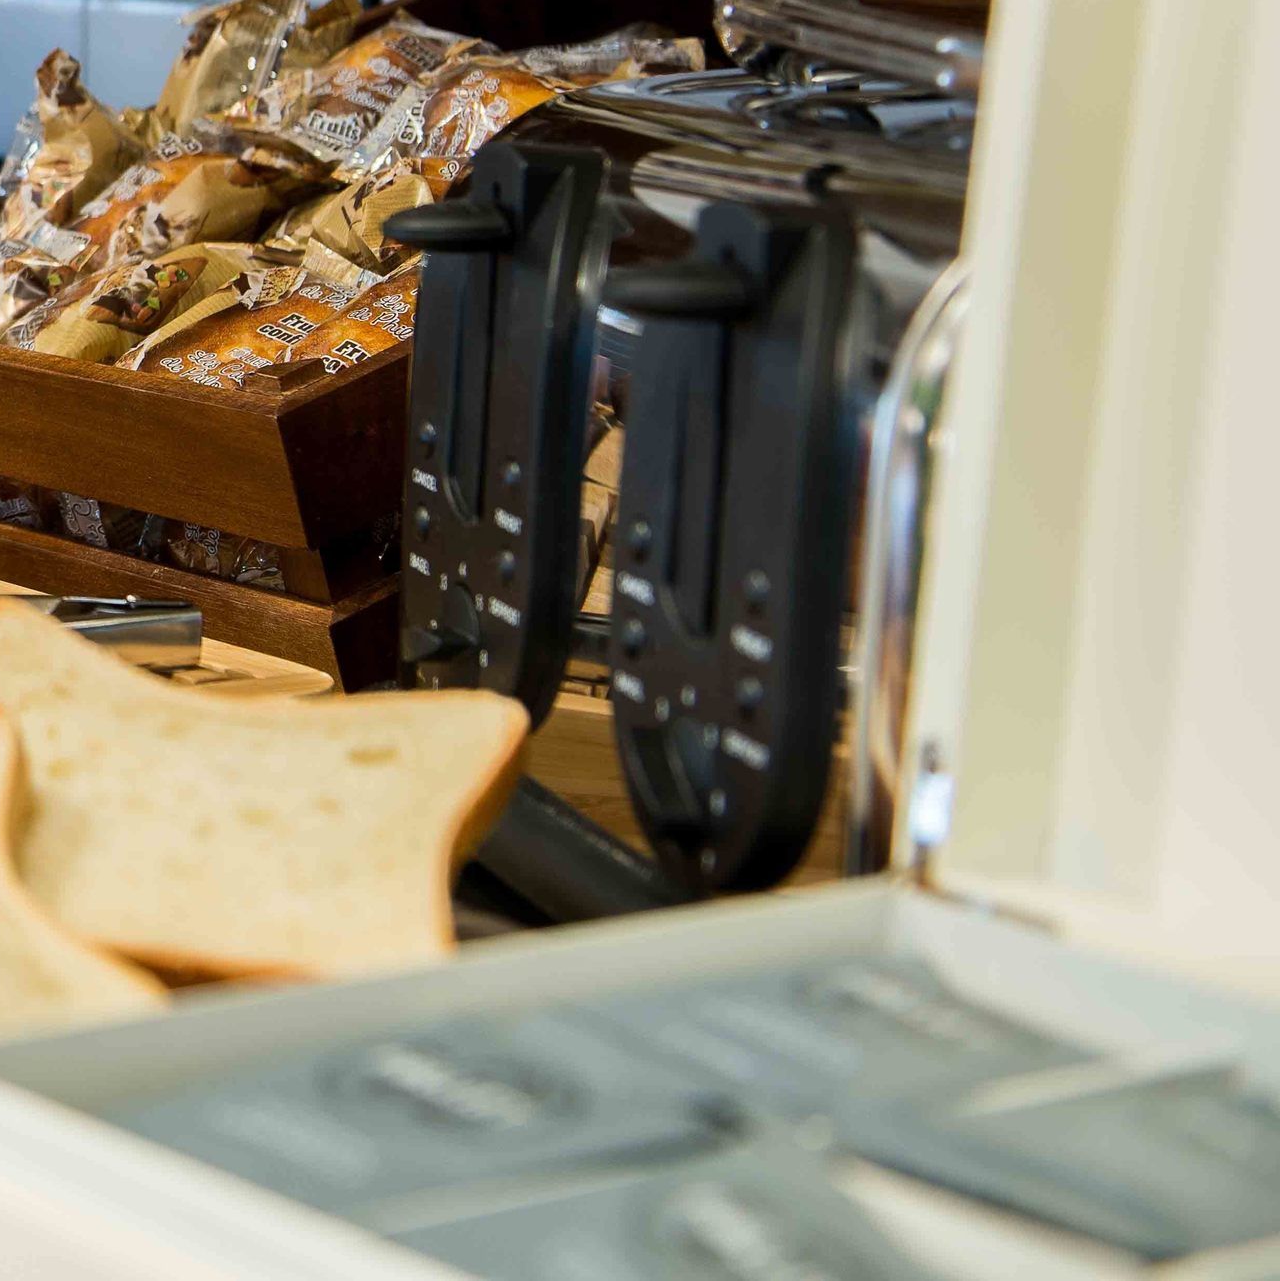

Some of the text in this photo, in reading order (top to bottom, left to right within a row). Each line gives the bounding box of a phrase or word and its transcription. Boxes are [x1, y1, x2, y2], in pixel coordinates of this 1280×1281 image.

[373, 294, 411, 314] Les
[348, 307, 372, 322] de
[160, 357, 184, 373] de
